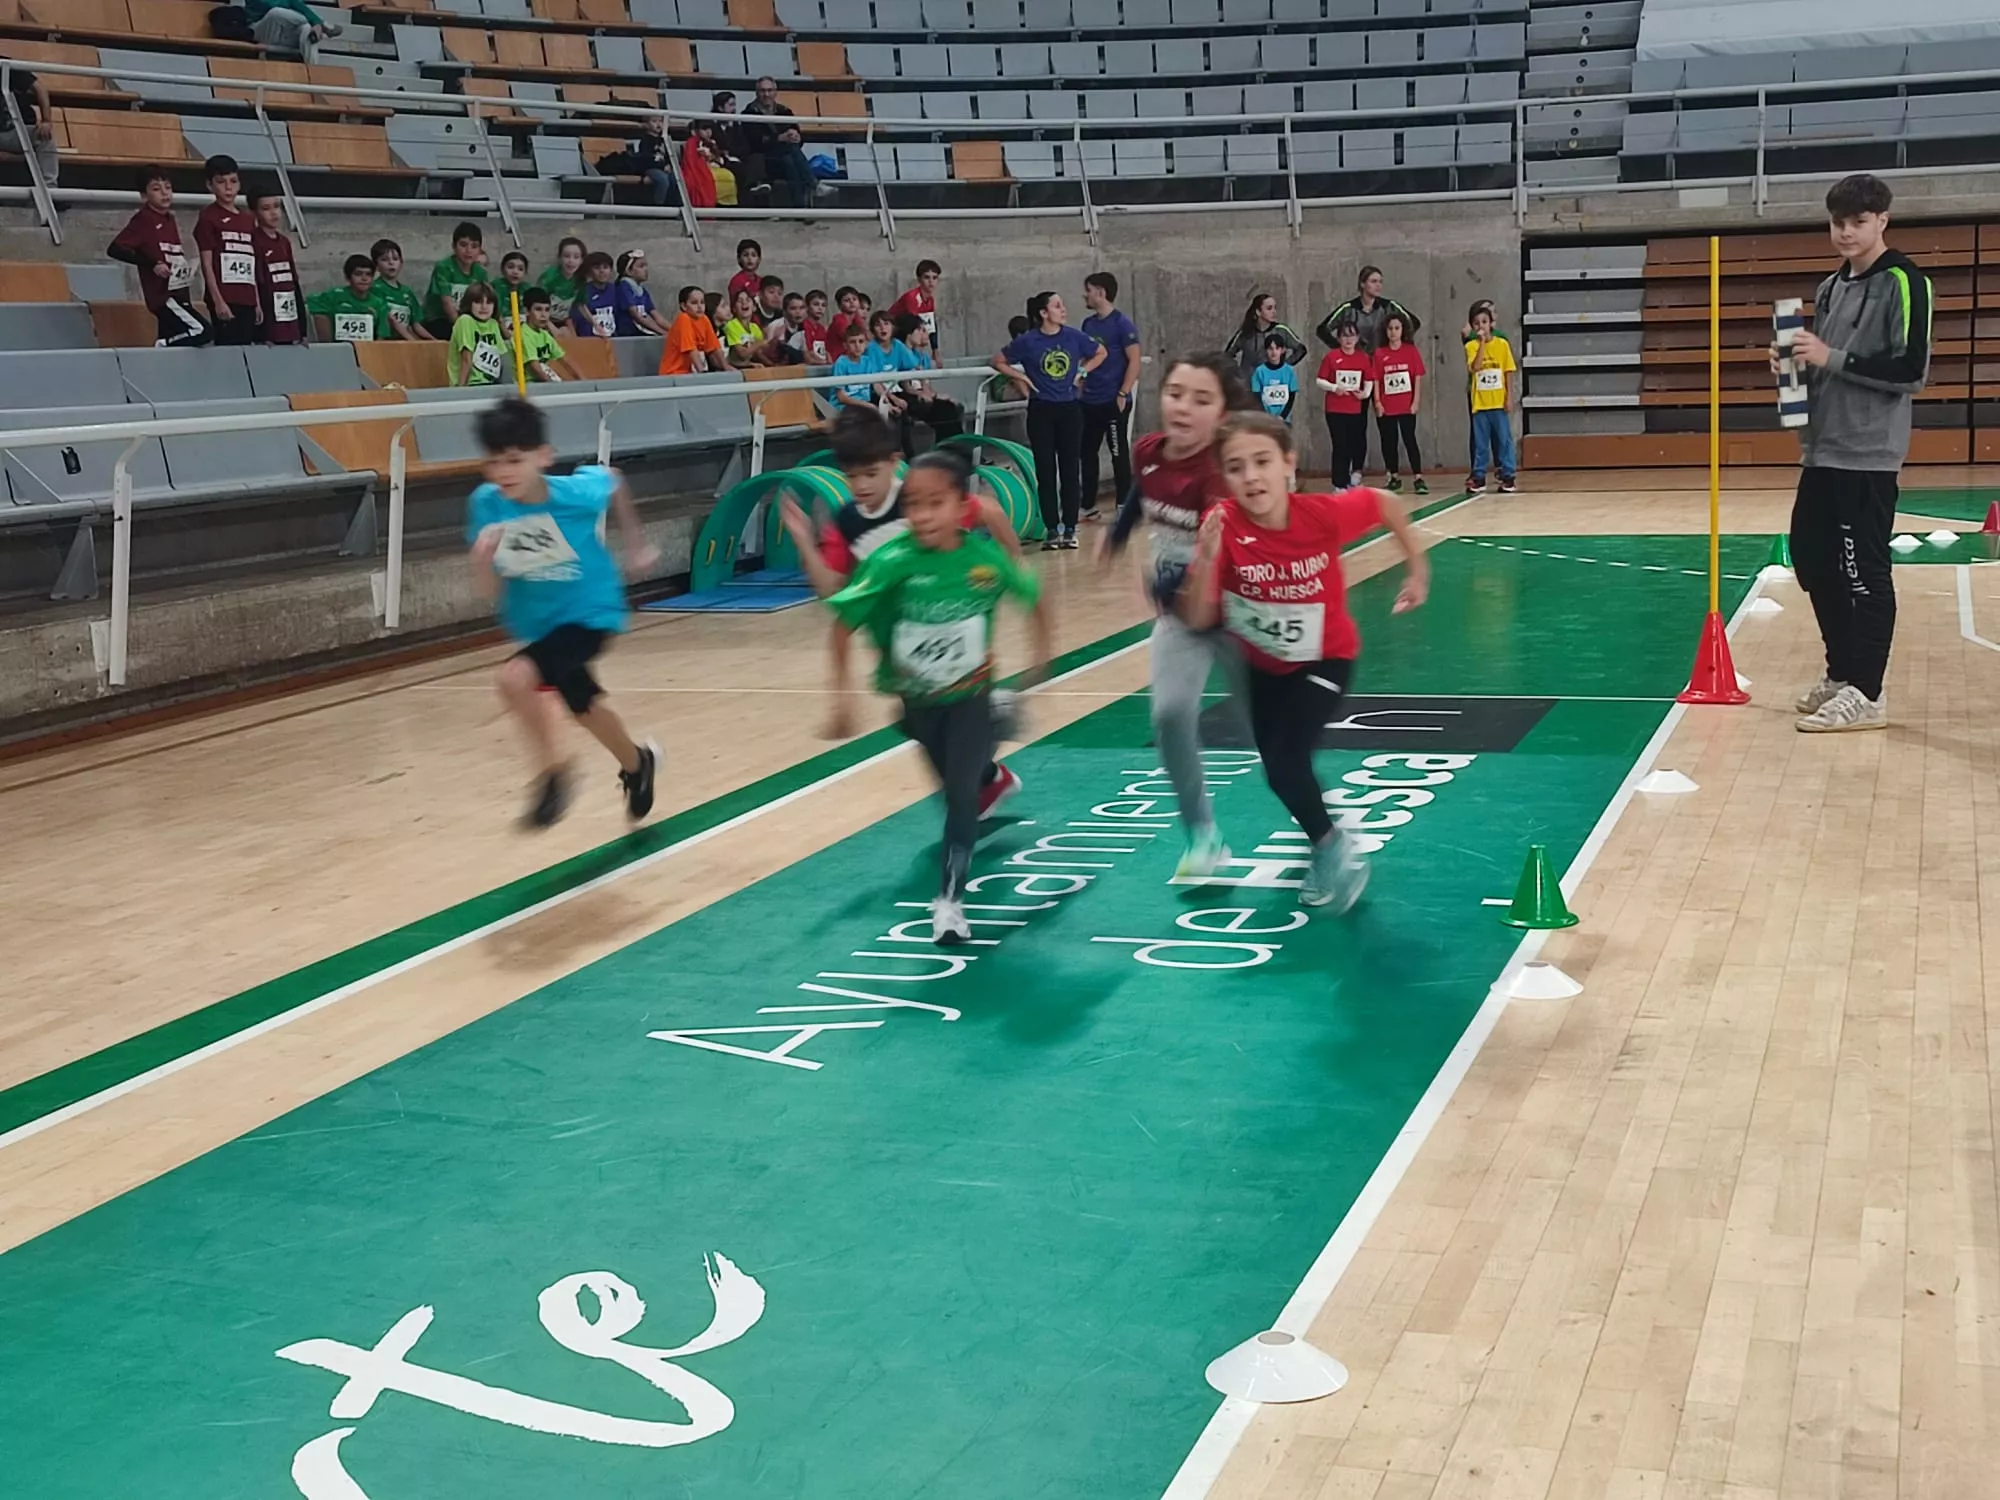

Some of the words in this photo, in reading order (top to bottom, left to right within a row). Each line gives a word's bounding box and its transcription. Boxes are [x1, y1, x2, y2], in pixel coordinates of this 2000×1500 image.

[341, 321, 367, 333] 498
[479, 351, 500, 368] 416
[1290, 551, 1330, 580] RUBIO
[1268, 576, 1325, 600] HUESCA
[1090, 907, 1310, 969] de
